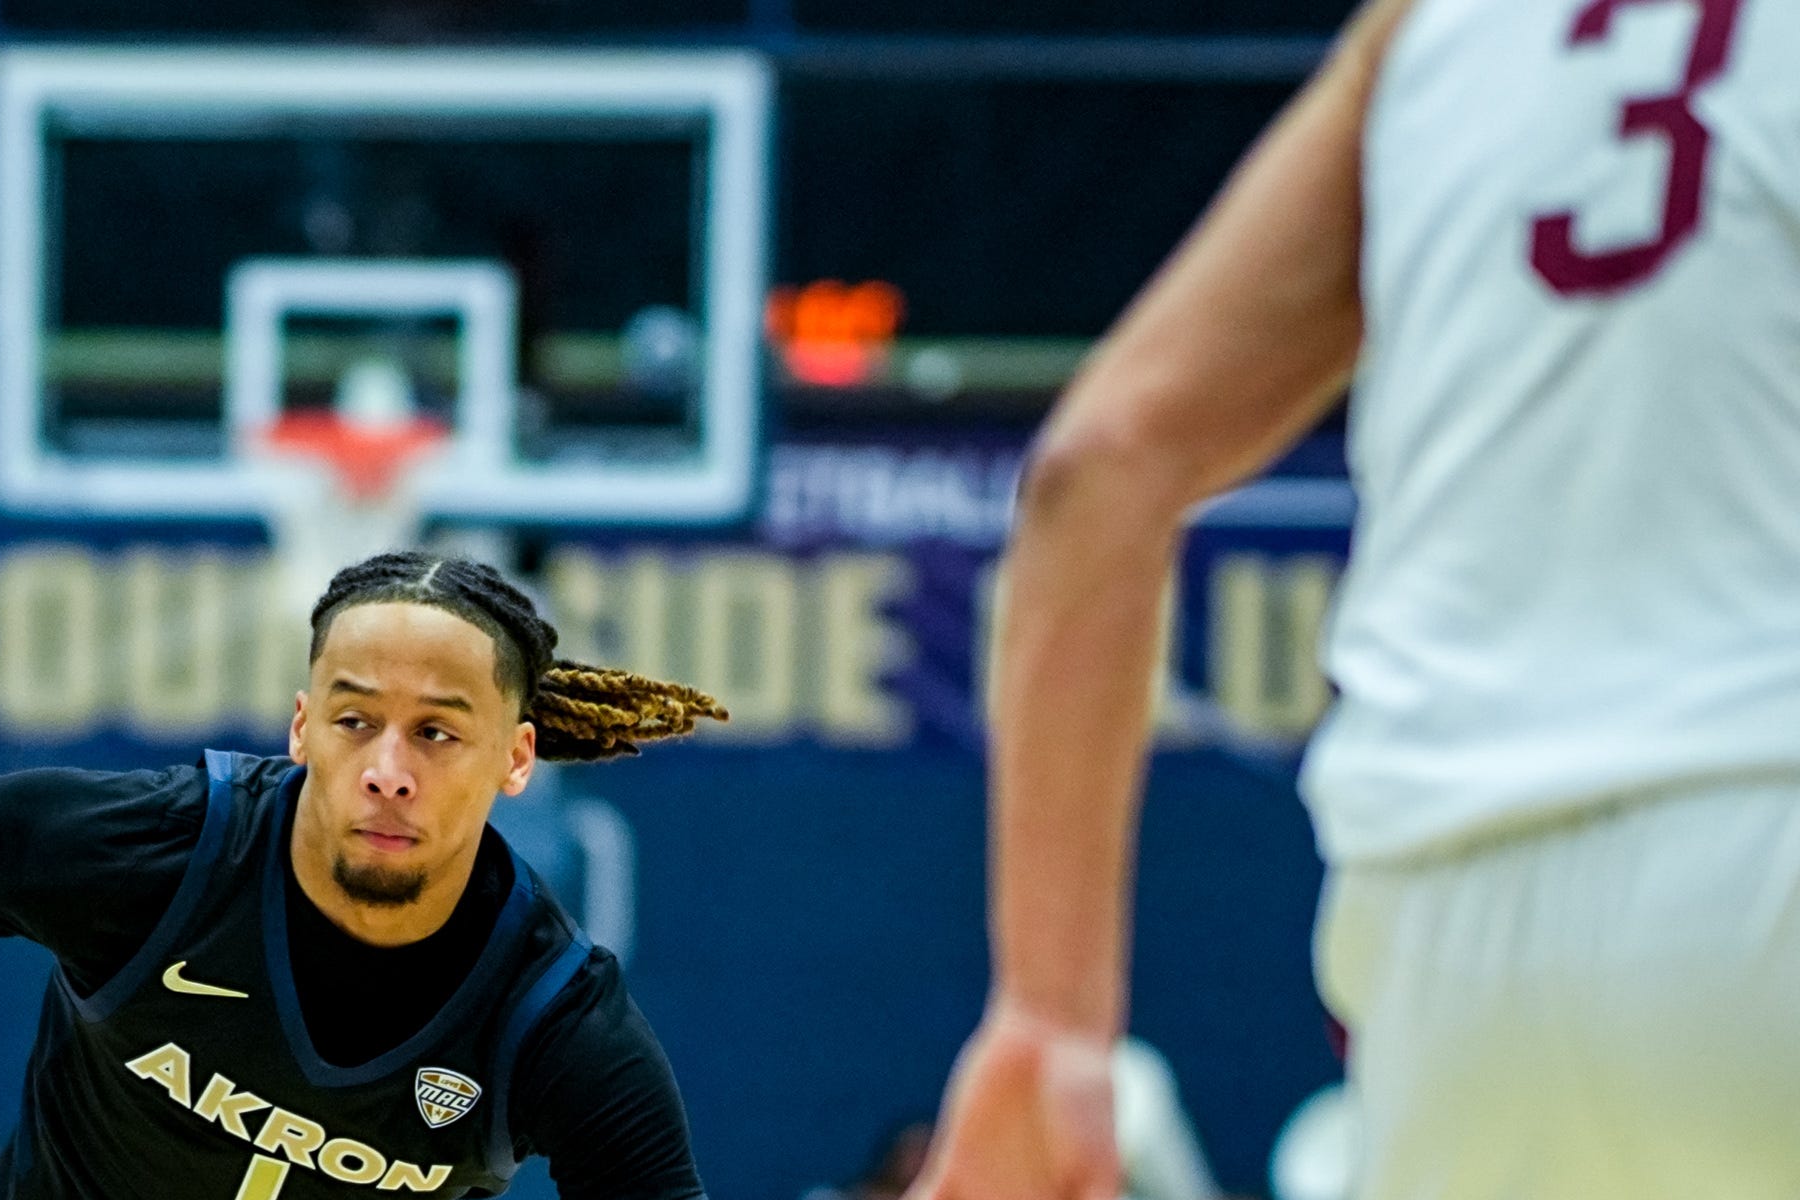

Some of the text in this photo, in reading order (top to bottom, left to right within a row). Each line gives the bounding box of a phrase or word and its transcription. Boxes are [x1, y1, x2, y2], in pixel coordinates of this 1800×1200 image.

[1531, 0, 1740, 294] 3
[125, 1042, 453, 1192] AKRON
[417, 1083, 472, 1112] MAC
